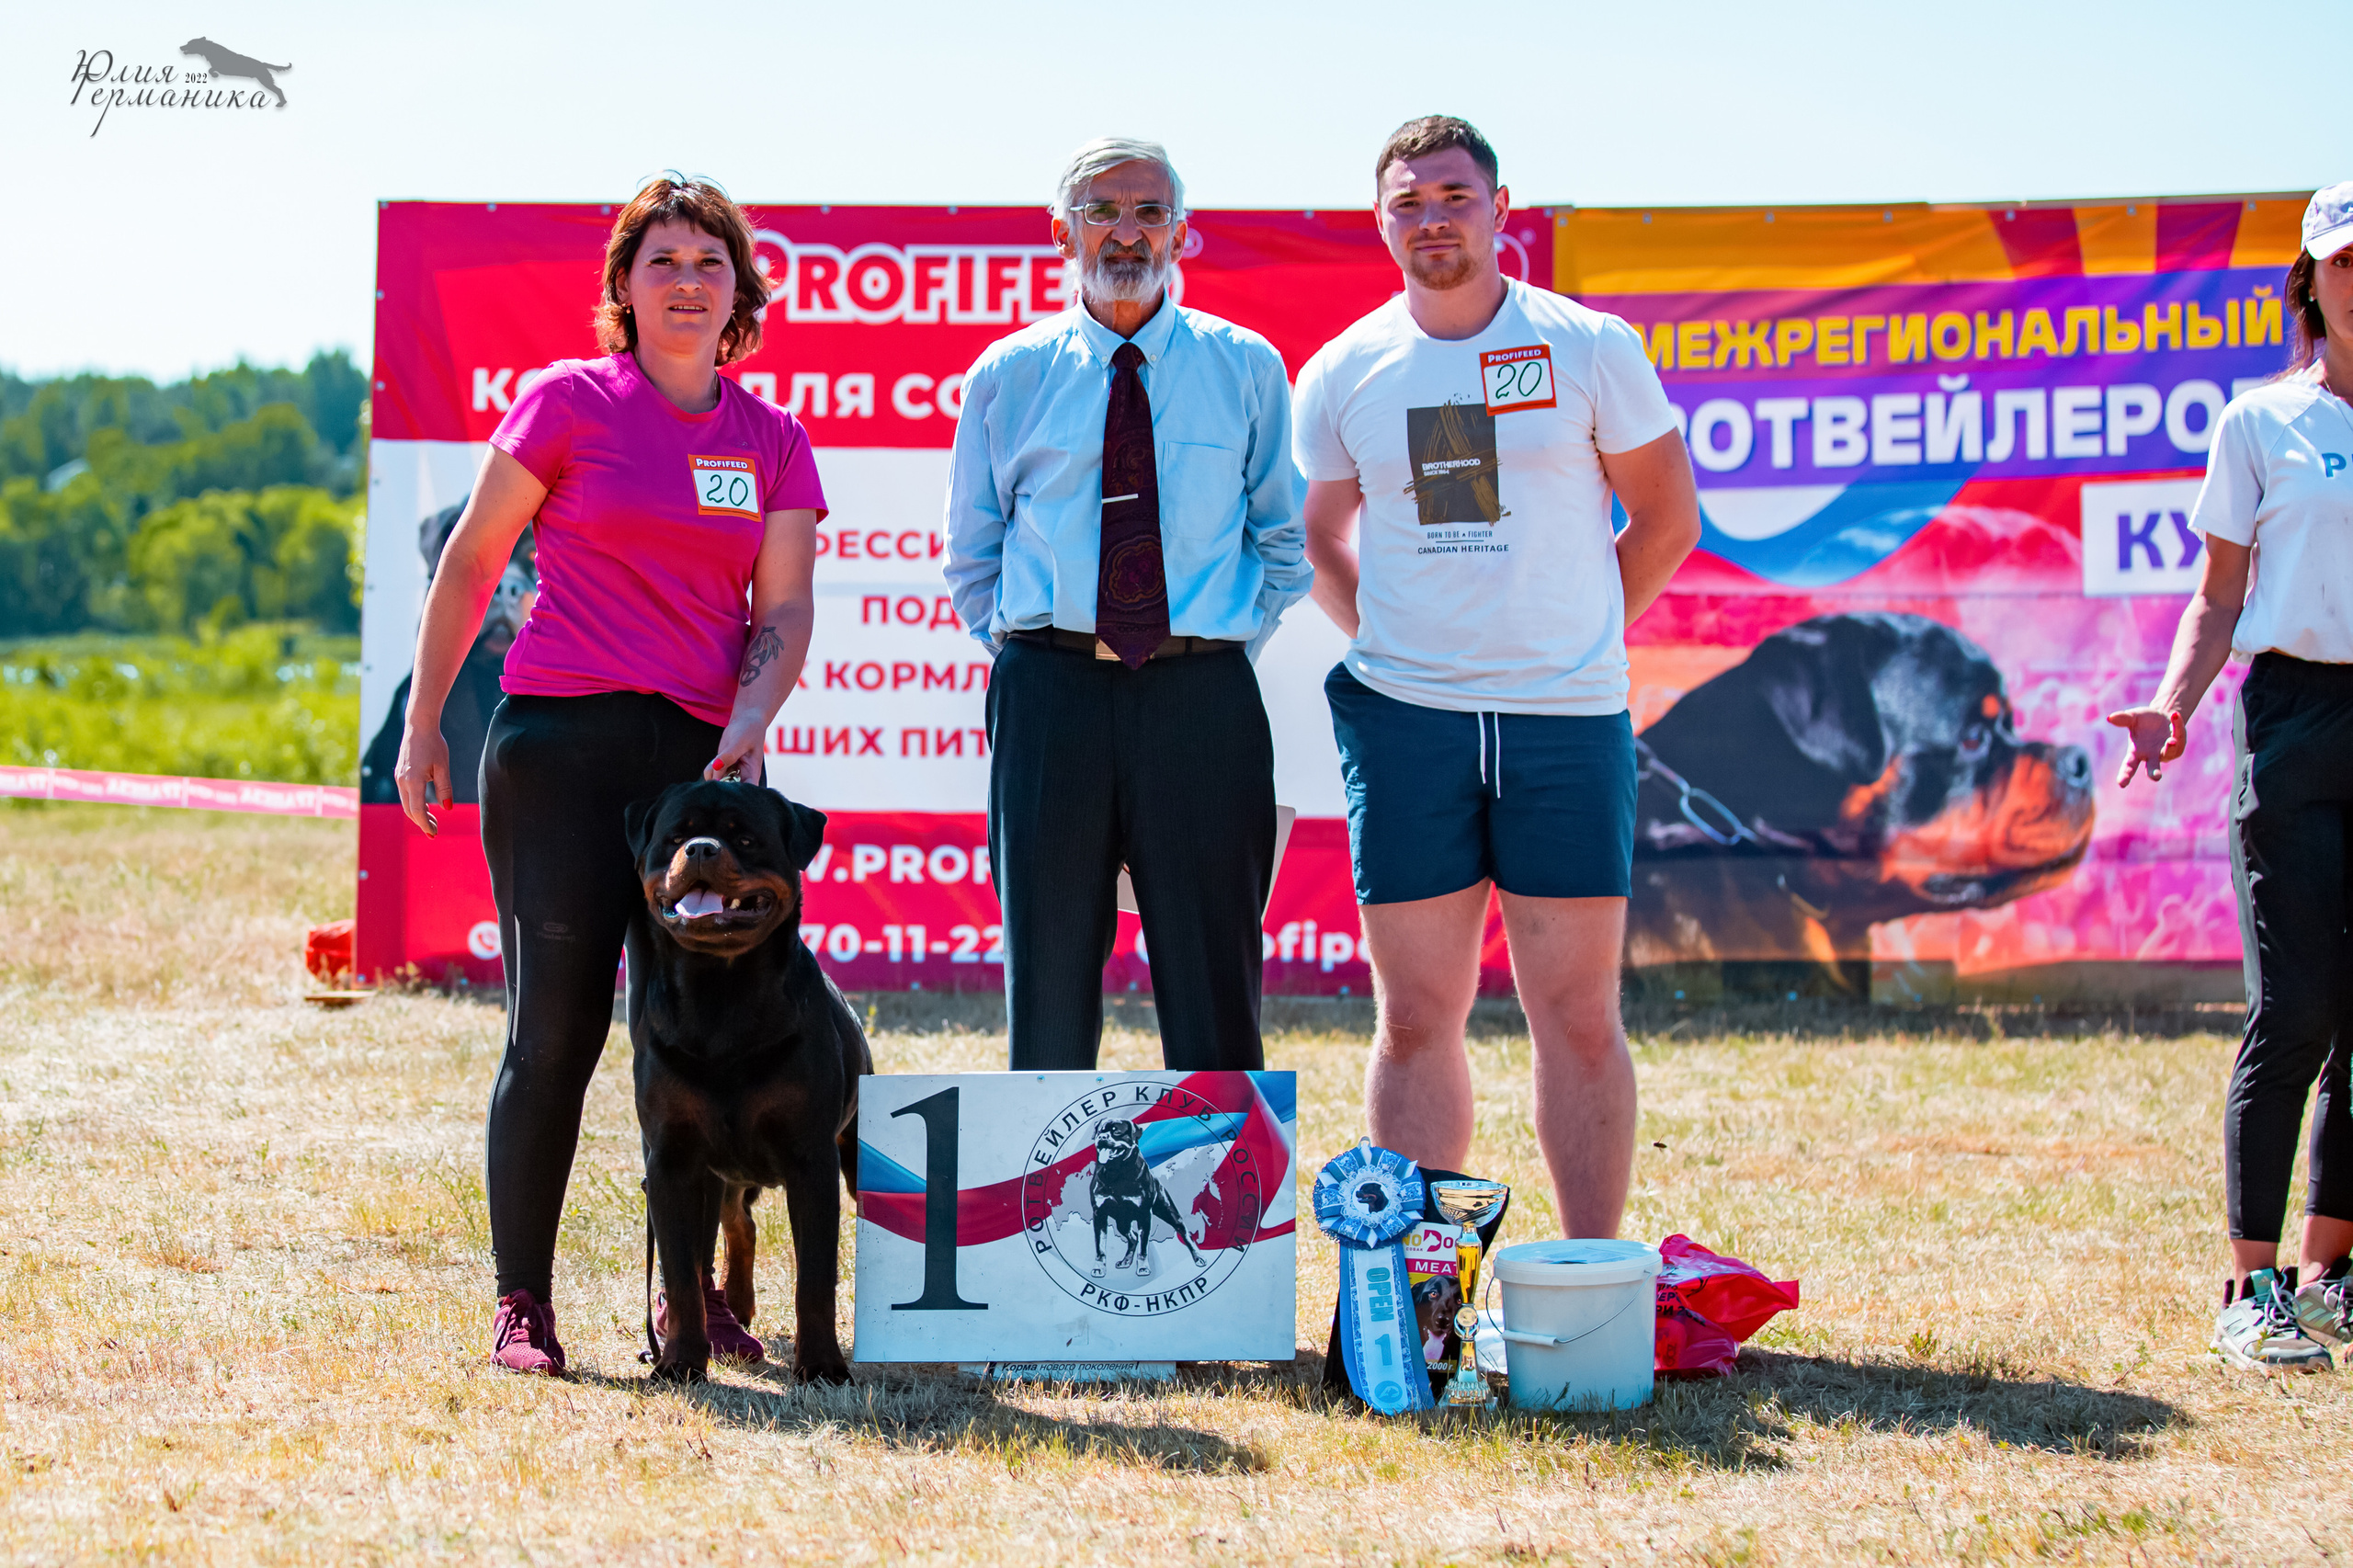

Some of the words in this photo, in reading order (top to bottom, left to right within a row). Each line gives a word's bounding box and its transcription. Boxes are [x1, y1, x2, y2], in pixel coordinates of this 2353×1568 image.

[1487, 349, 1541, 363] PROFIFEED
[1495, 361, 1542, 399] 20
[695, 458, 748, 469] PROFIFEED
[1422, 458, 1482, 471] BROTHERHOOD
[706, 473, 749, 507] 20
[1417, 546, 1458, 554] CANADIAN
[1461, 544, 1509, 552] HERITAGE
[764, 726, 884, 756] ШИХ
[1026, 1091, 1116, 1255] РОТВЕЙЛЕР
[1135, 1086, 1214, 1121] КЛУБ
[1221, 1128, 1257, 1253] РОССИИ
[891, 1086, 988, 1311] 1
[1080, 1277, 1208, 1312] РКФ-НКПР
[1366, 1267, 1394, 1322] OPEN
[1375, 1334, 1392, 1366] 1
[1427, 1361, 1448, 1370] 2000
[1002, 1363, 1038, 1373] Корма
[1040, 1363, 1075, 1371] нового
